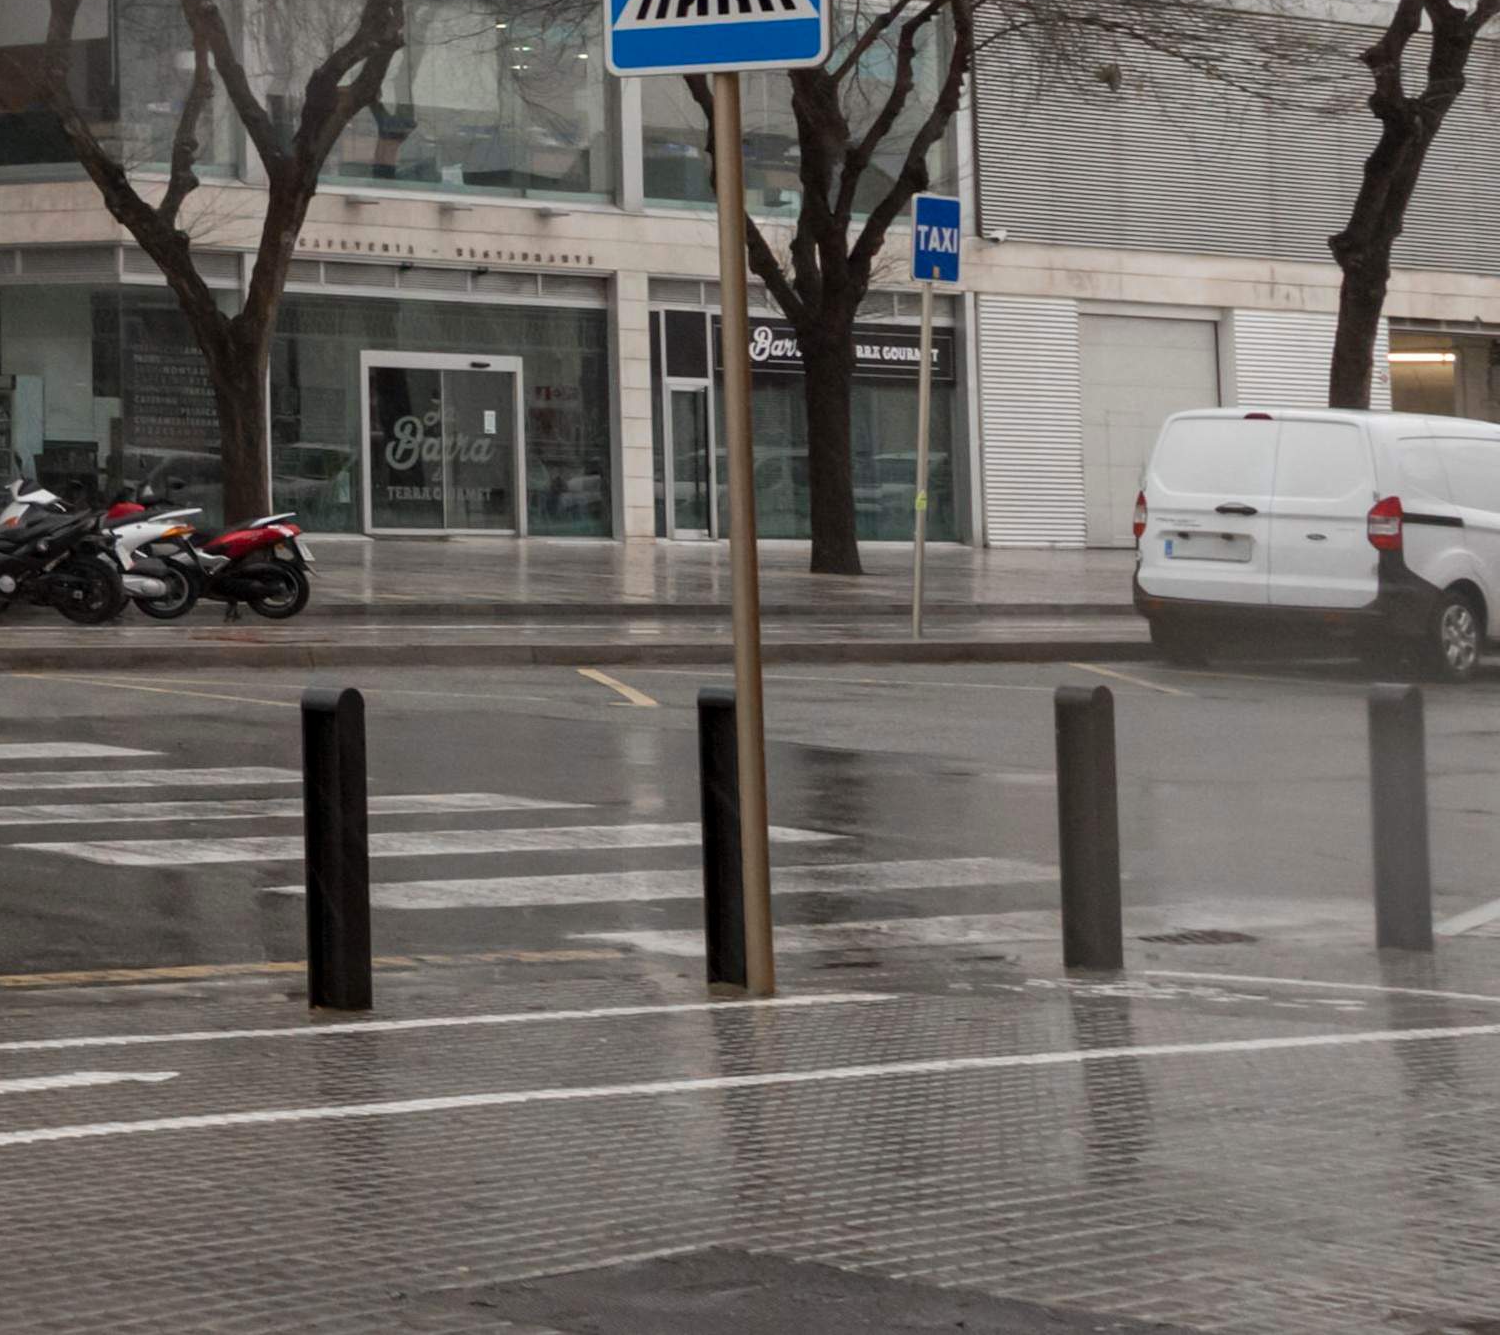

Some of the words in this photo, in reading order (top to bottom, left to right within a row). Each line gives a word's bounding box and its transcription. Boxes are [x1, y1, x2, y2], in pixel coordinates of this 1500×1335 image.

[299, 237, 415, 255] CAFETERIA
[456, 248, 595, 266] RESTAURANTE
[917, 224, 958, 254] TAXI
[750, 326, 803, 361] Bar
[855, 344, 882, 361] RRA
[882, 345, 939, 363] GOURMT
[385, 415, 495, 471] Barra
[387, 486, 431, 502] TERRA
